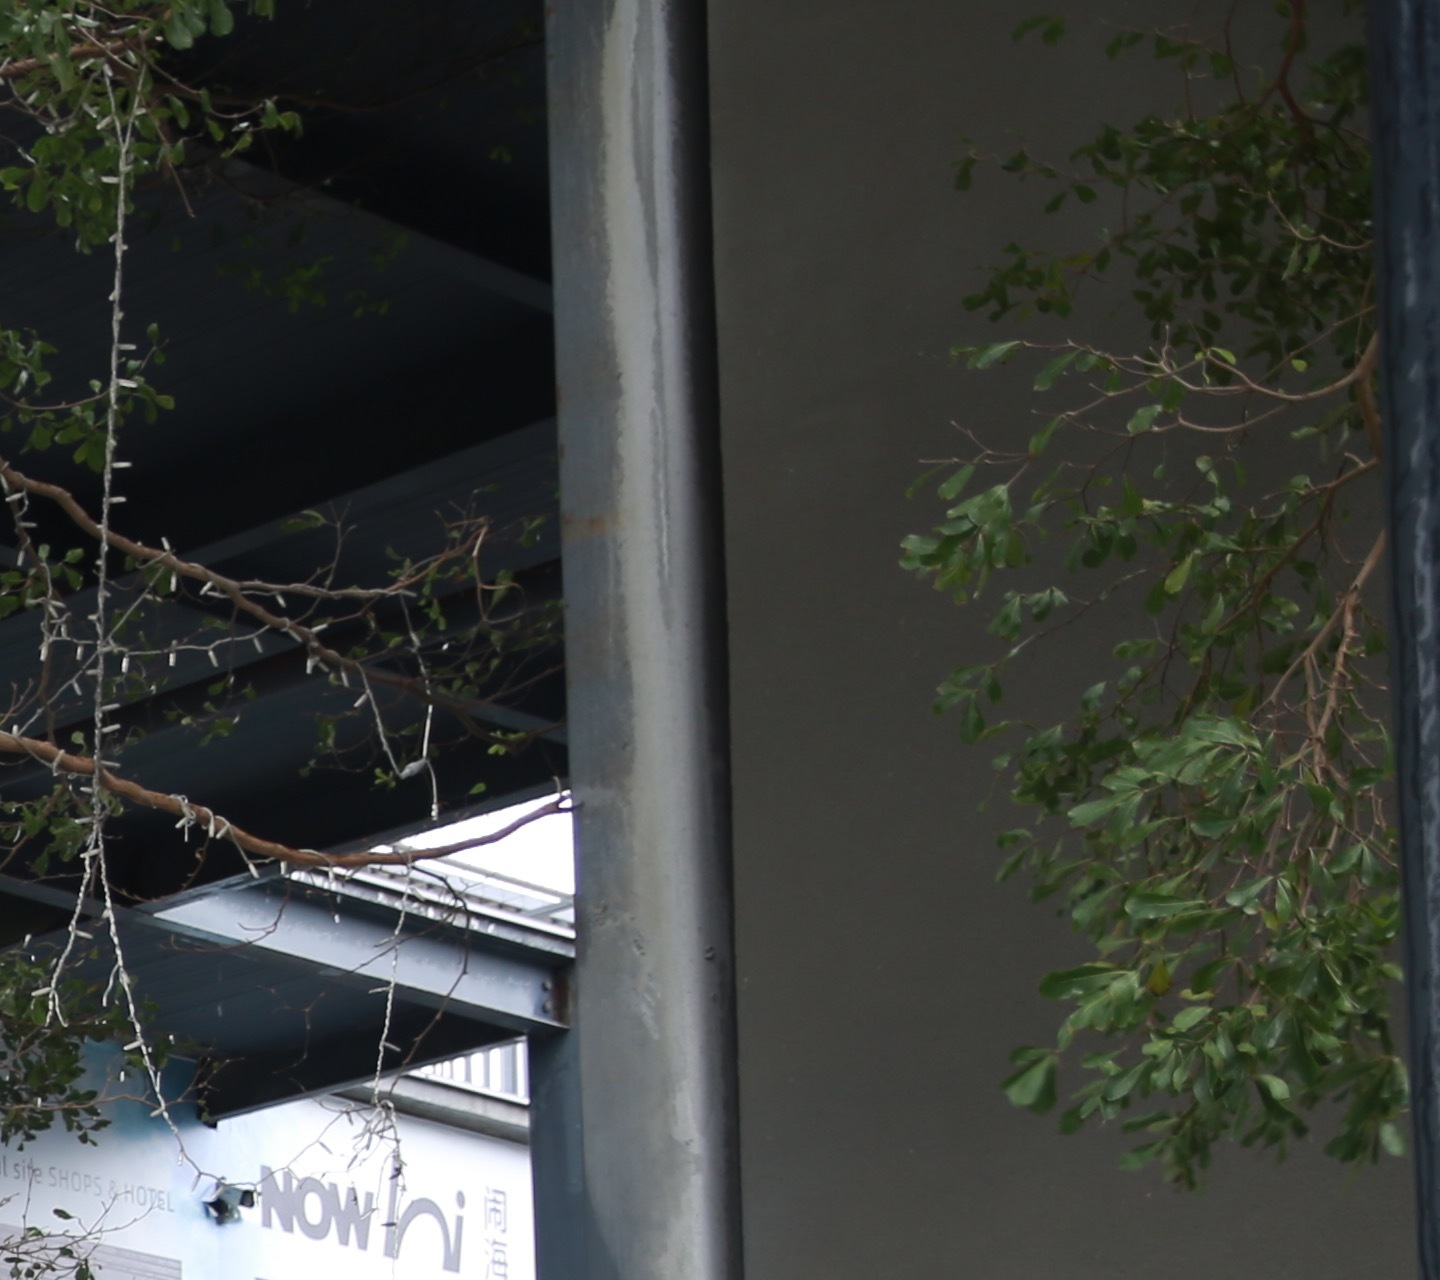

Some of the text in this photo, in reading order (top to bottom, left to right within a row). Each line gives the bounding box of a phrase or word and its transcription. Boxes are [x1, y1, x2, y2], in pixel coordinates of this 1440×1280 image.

[13, 1160, 43, 1185] site
[48, 1166, 103, 1198] SHOPS
[108, 1183, 124, 1201] &
[125, 1184, 176, 1214] HOTEL
[260, 1163, 375, 1252] NOW
